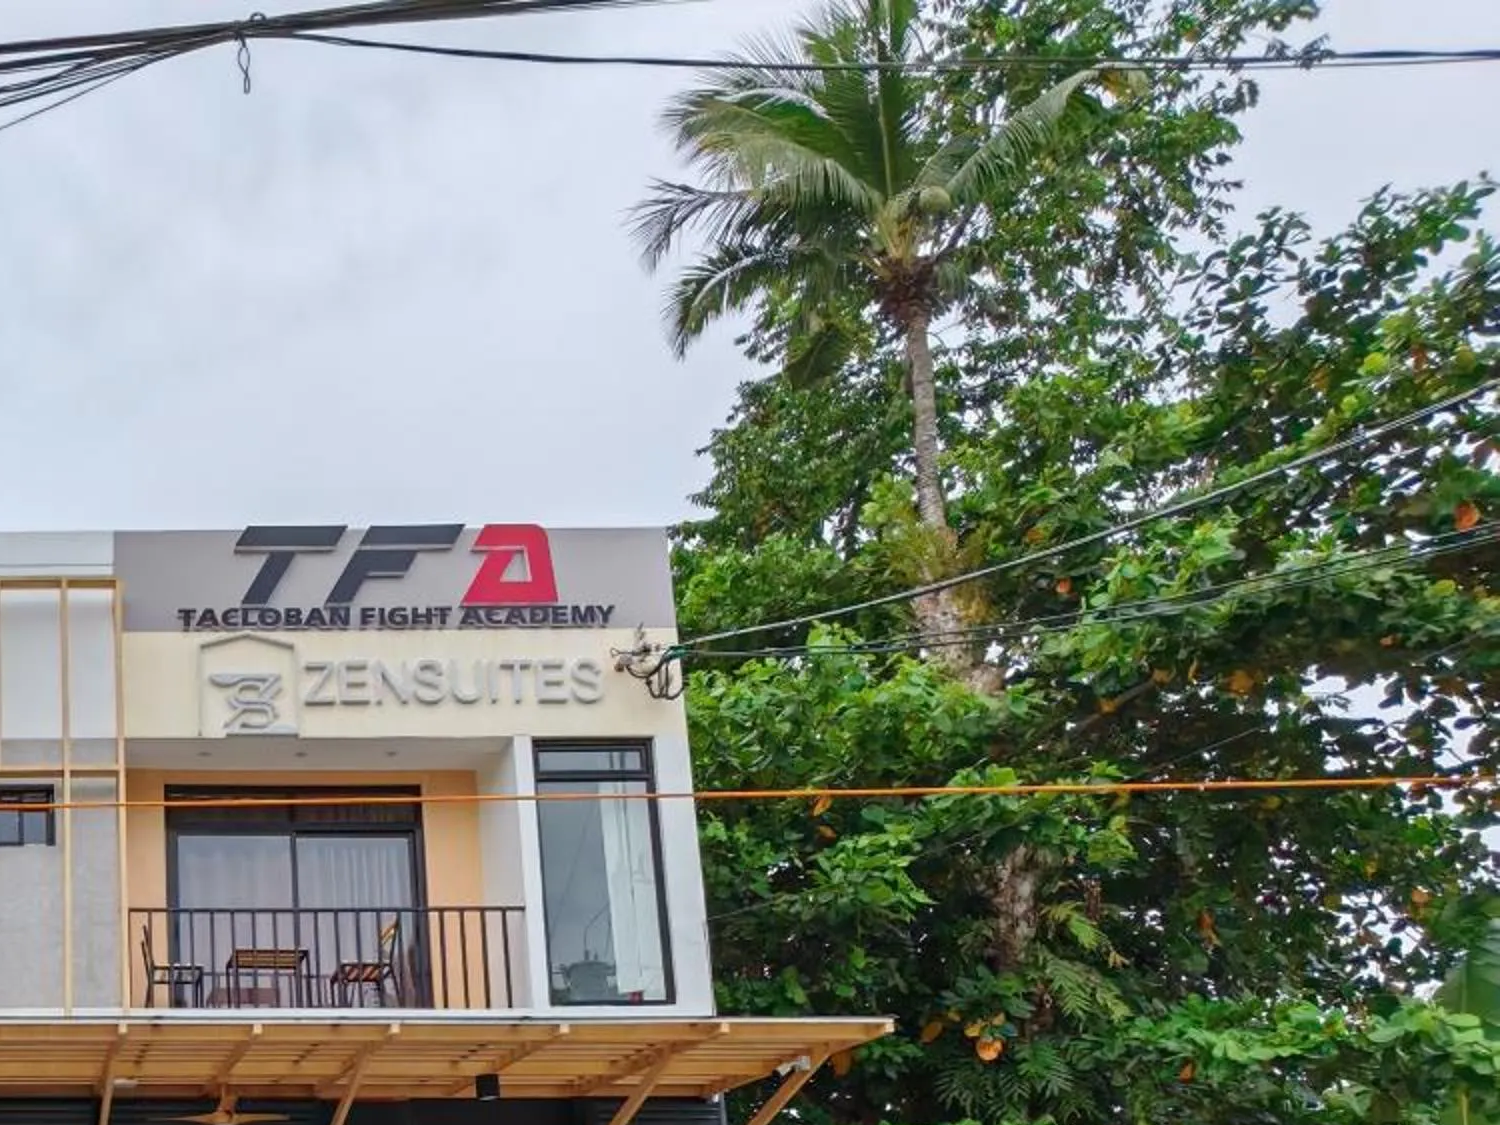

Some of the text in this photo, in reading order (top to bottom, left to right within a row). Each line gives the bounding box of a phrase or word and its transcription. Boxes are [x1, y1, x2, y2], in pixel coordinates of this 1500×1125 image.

[233, 523, 559, 609] TFA
[177, 604, 617, 630] TACLOBAN FIGHT ACADEMY
[302, 658, 605, 706] ZENSUITES
